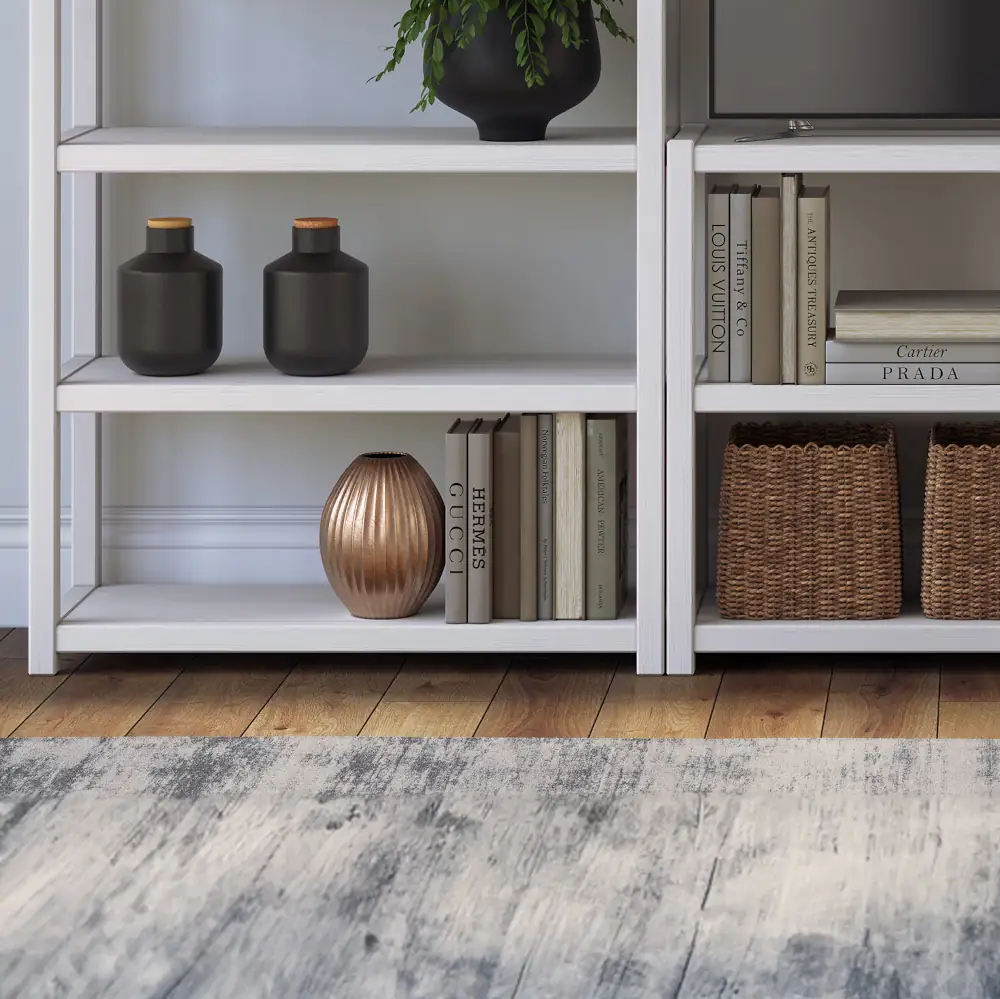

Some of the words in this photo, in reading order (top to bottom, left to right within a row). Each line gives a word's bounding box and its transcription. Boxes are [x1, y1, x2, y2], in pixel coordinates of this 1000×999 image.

[711, 224, 726, 274] LOUIS
[735, 240, 748, 295] Tiffany
[806, 228, 817, 286] ANTIQUES
[711, 278, 726, 354] VUITTON
[737, 299, 748, 311] &
[807, 287, 817, 348] TREASURY
[736, 317, 748, 337] Co
[896, 343, 948, 359] Cartier
[882, 366, 960, 381] PRADA
[541, 429, 550, 470] Norwegian
[542, 470, 550, 504] Folktales
[597, 468, 605, 514] AMERICAN
[449, 482, 464, 575] GUCCI
[597, 519, 605, 554] PEWTER
